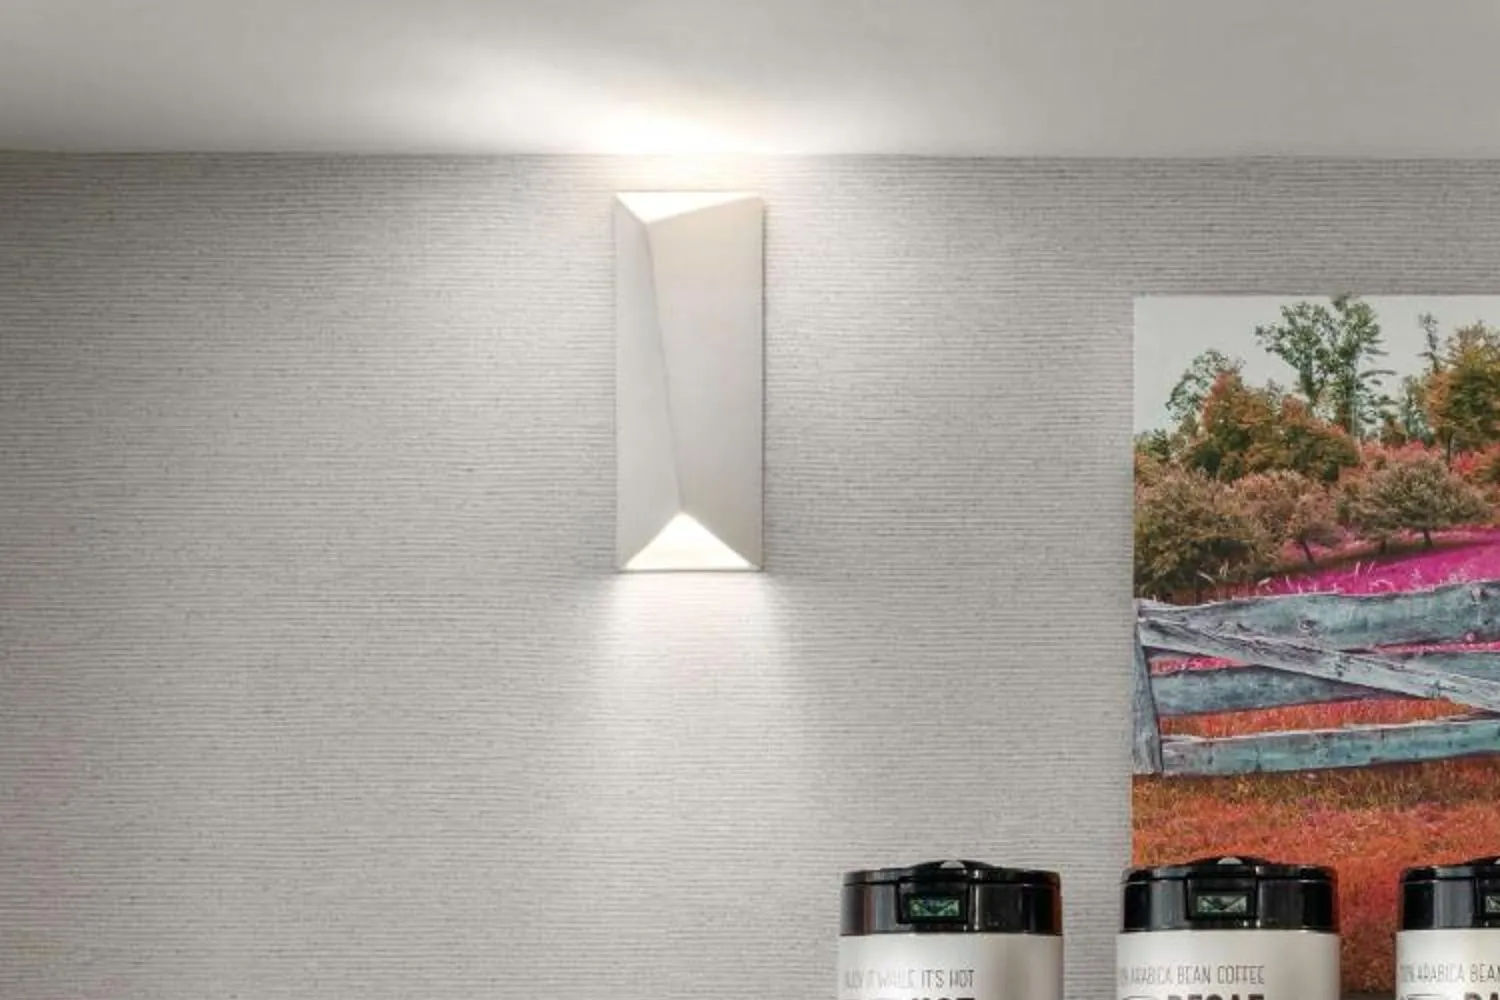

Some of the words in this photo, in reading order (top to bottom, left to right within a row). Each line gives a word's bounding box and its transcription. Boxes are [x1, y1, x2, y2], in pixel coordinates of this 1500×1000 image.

[949, 969, 975, 988] HOT
[1176, 965, 1212, 985] BEAN
[1217, 965, 1265, 985] COFFEE
